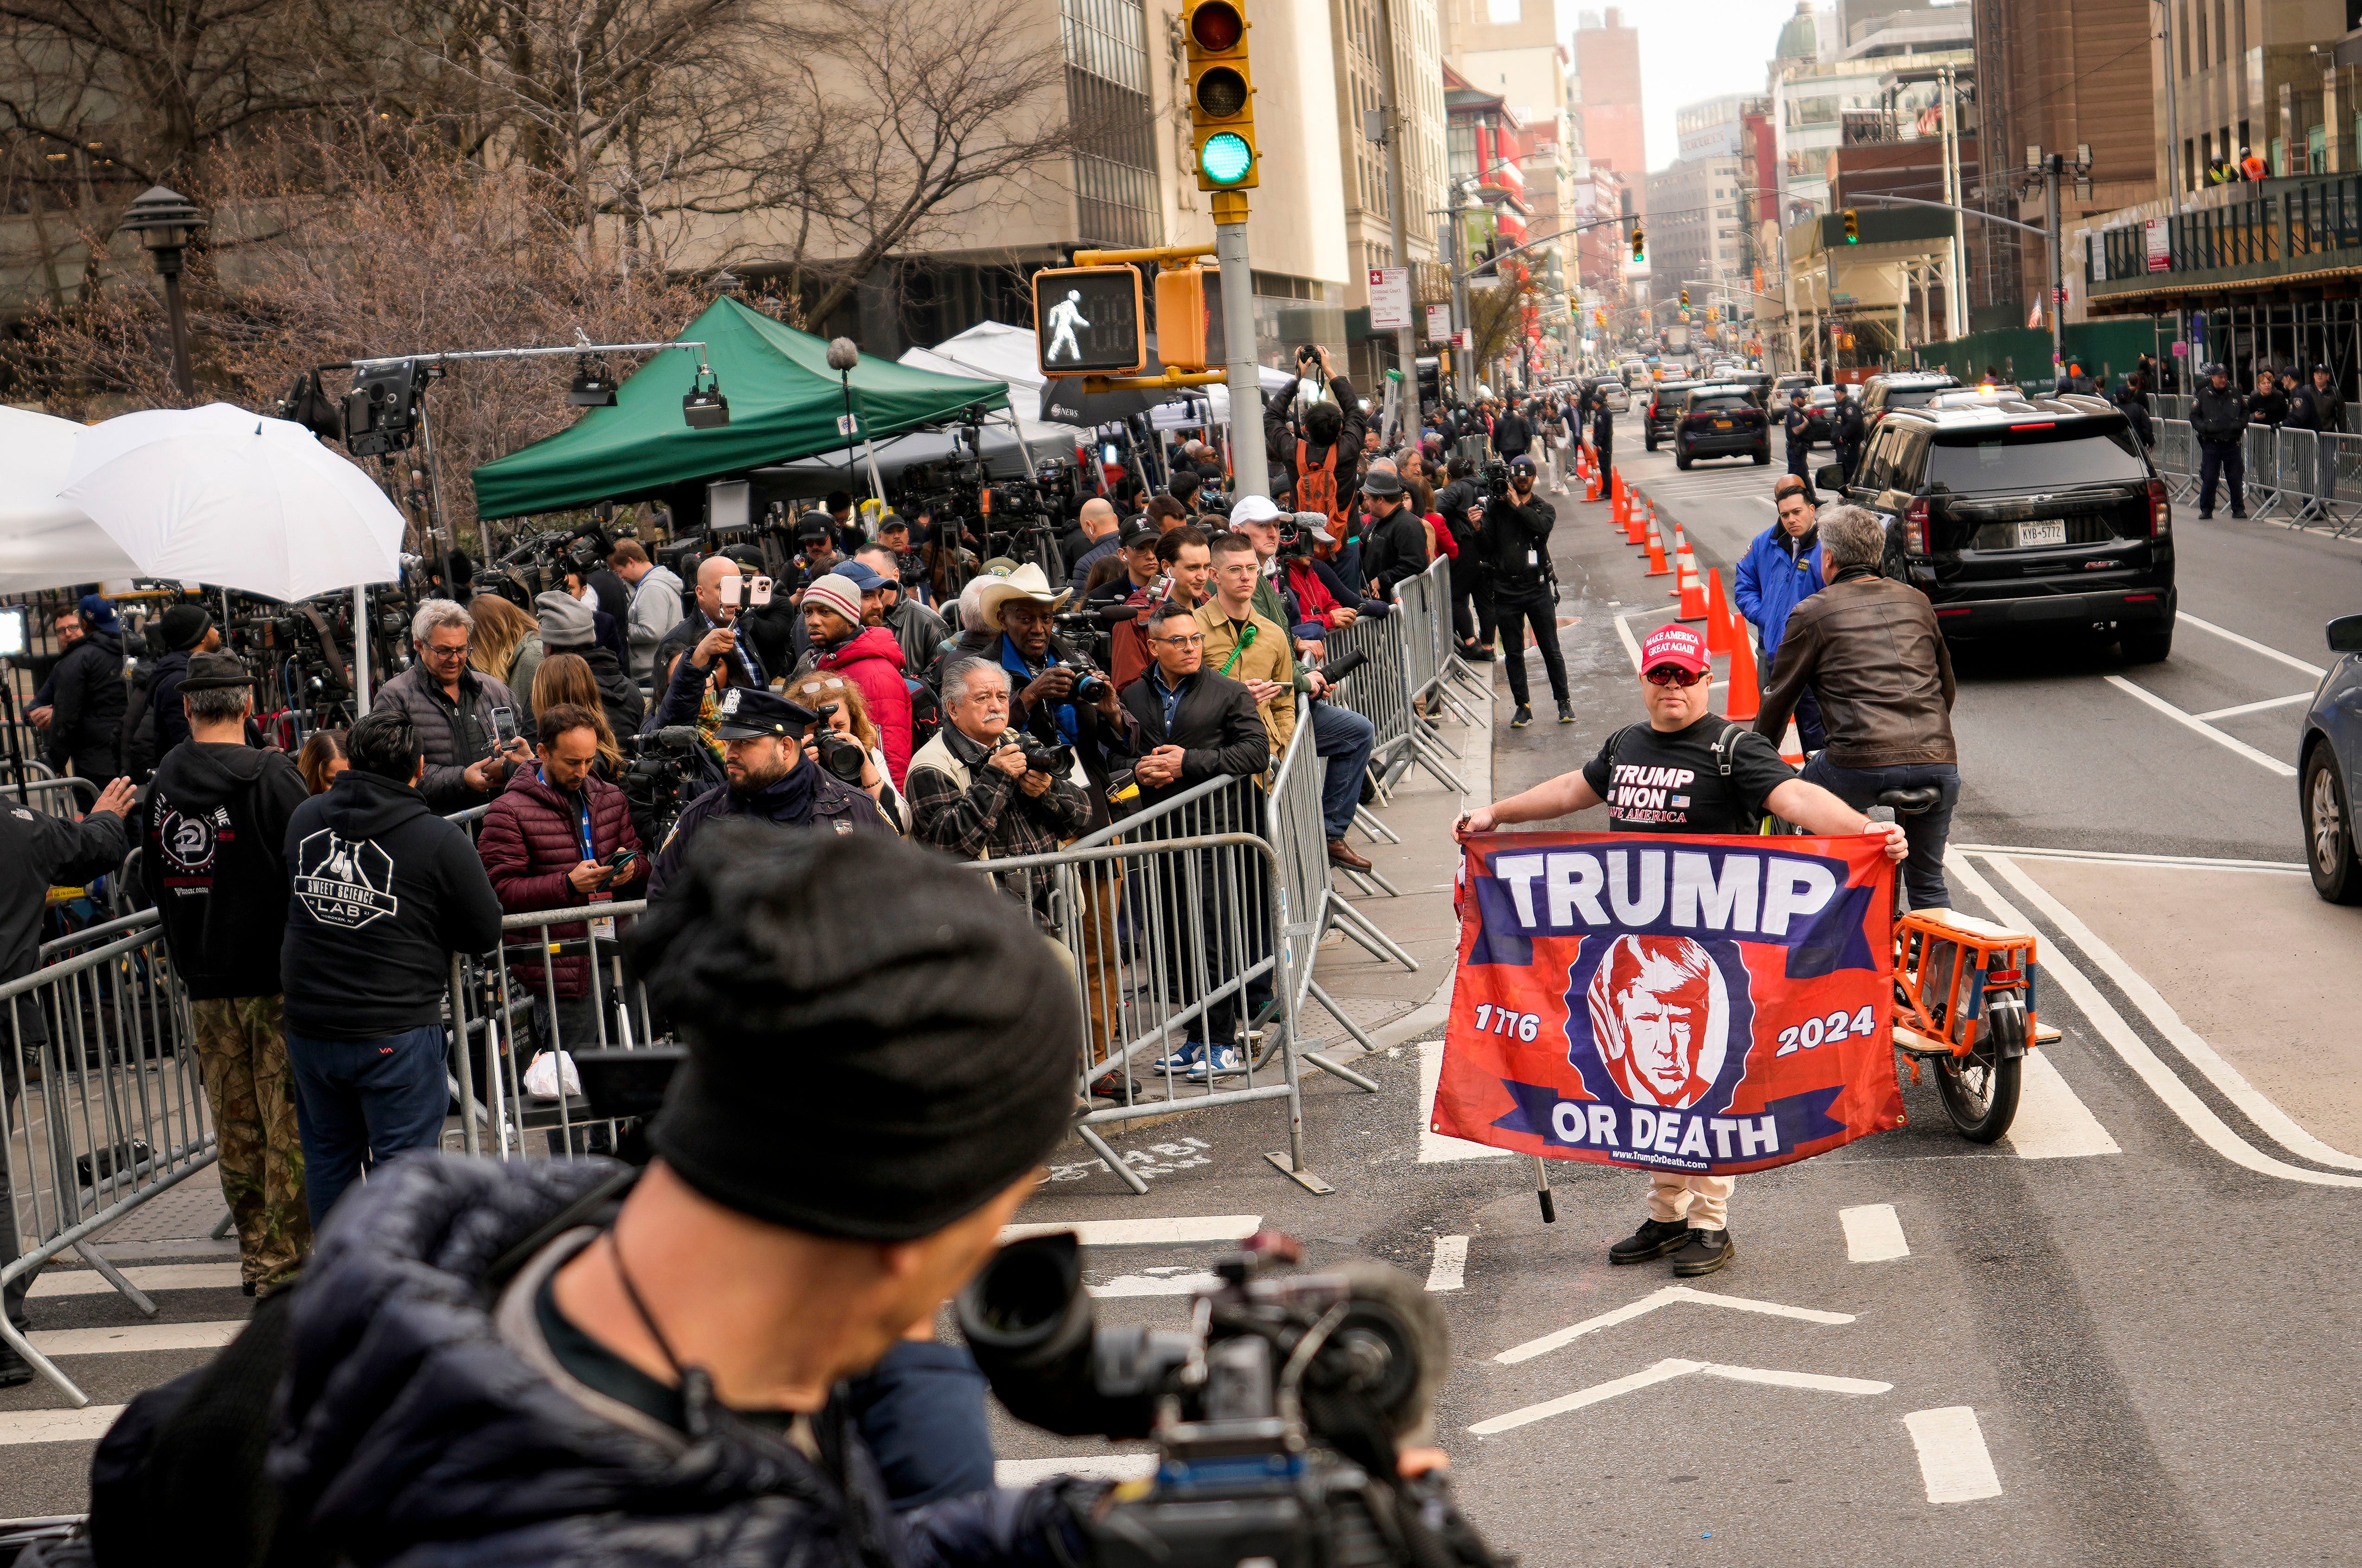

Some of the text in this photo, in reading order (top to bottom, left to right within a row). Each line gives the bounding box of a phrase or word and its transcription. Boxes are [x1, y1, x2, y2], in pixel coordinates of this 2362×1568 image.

[1060, 408, 1078, 417] NEWS
[1645, 630, 1699, 647] MAKE AMERICA
[1648, 642, 1695, 657] GREAT AGAIN
[1613, 764, 1695, 788] TRUMP
[1617, 786, 1667, 809] WON
[1608, 806, 1687, 823] AVE AMERICA
[308, 880, 375, 905] SWEET SCIENCE
[1496, 848, 1837, 936] TRUMP
[317, 899, 360, 917] LAB
[321, 914, 346, 922] HOBOKEN,
[1474, 1002, 1541, 1043] 1776
[1775, 1005, 1875, 1058] 2024
[1552, 1101, 1780, 1158] OR DEATH
[1612, 1150, 1707, 1169] www.TrumpOrDeath.com
